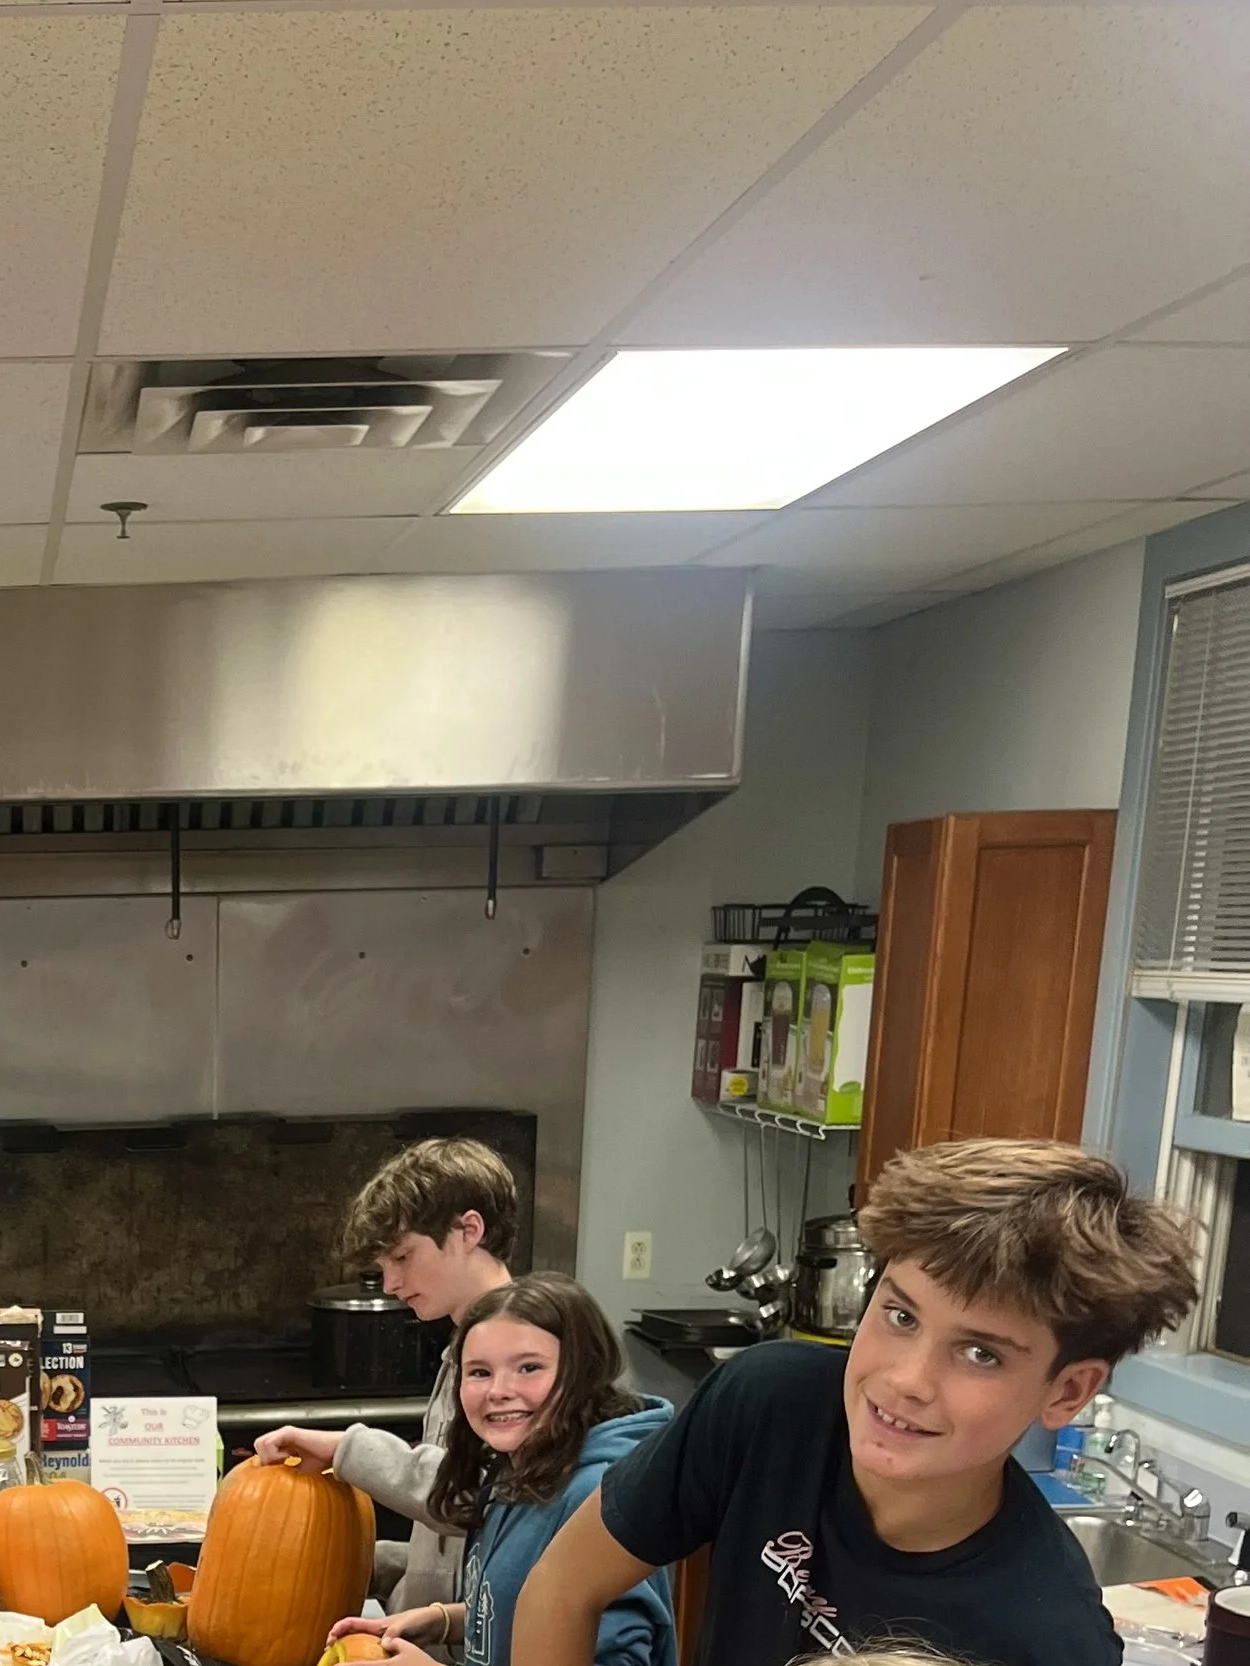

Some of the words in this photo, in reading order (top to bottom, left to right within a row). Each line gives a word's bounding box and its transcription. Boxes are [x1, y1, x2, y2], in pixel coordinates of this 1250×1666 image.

[62, 1343, 72, 1354] 13
[141, 1408, 158, 1416] This
[144, 1422, 164, 1432] OUR
[108, 1437, 161, 1446] COMMUNITY
[164, 1437, 200, 1446] KITCHEN
[43, 1453, 91, 1470] eynold
